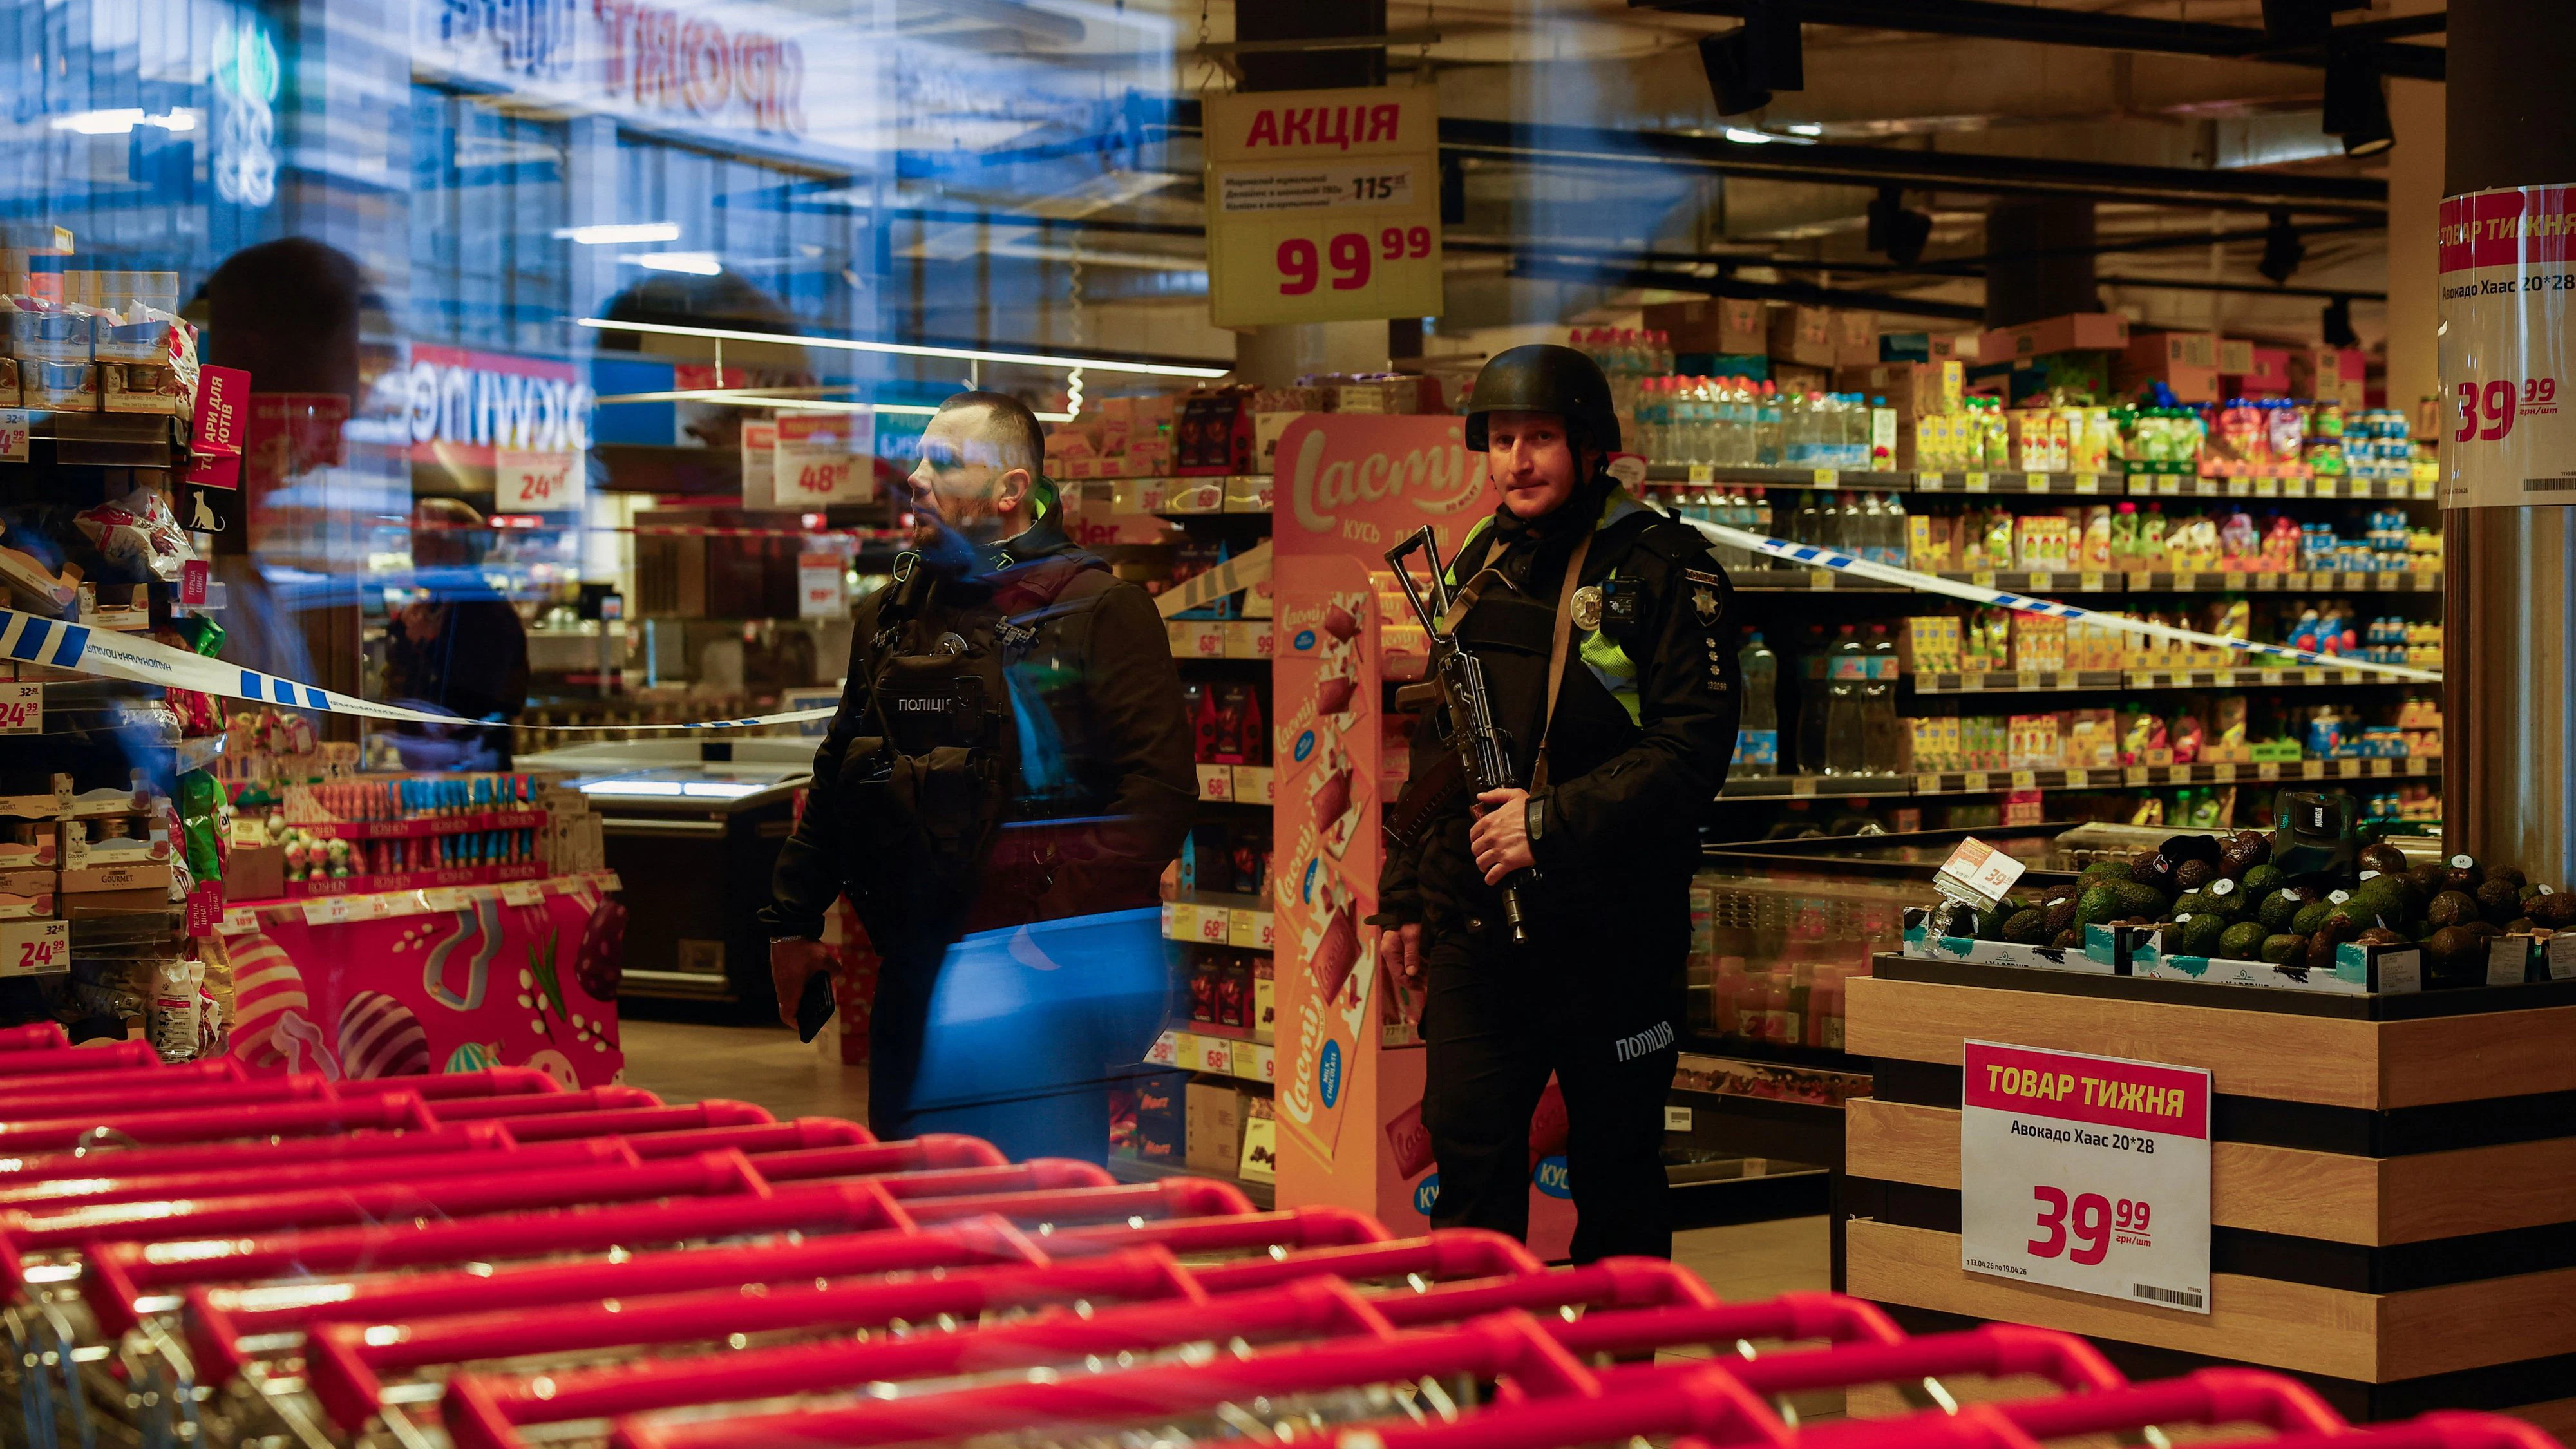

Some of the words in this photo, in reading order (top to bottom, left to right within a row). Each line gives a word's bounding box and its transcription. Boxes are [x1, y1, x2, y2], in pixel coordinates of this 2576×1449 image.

[1245, 103, 1400, 151] АКЦІЯ
[1352, 176, 1393, 200] 115
[1276, 233, 1372, 296] 99
[1381, 225, 1432, 260] 99
[2443, 284, 2478, 301] Авокадо
[2481, 279, 2515, 295] Хаас
[209, 375, 223, 410] ДЛЯ
[2456, 380, 2517, 443] 39
[2521, 378, 2556, 402] 99
[2519, 406, 2558, 416] грн/шт
[13, 430, 24, 439] 99
[520, 474, 551, 500] 24
[800, 464, 835, 492] 48
[1293, 426, 1464, 533] Lacmi
[1075, 518, 1120, 545] der
[1343, 518, 1381, 544] КУСЬ
[86, 643, 117, 659] ПОЛІЦІЯ
[117, 651, 173, 672] НАЦІОНАЛЬНА
[0, 703, 25, 727] 24
[26, 703, 37, 711] 99
[101, 875, 134, 884] GOURMET
[1985, 868, 2007, 886] 39
[1204, 920, 1220, 938] 68
[19, 941, 52, 967] 24
[53, 940, 64, 949] 99
[1616, 1020, 1674, 1063] ПОЛІЦІЯ
[1208, 1050, 1224, 1068] 68
[1266, 1060, 1274, 1077] 9
[1986, 1064, 2075, 1102] ТОВАР
[2080, 1077, 2186, 1119] ТИЖНЯ
[2011, 1119, 2071, 1144] Авокадо
[2074, 1128, 2109, 1148] Хаас
[1540, 1163, 1569, 1190] КУС
[2027, 1185, 2112, 1266] 39
[2116, 1198, 2152, 1231] 99
[2116, 1234, 2152, 1248] грн/шт
[1971, 1258, 1994, 1271] 13.04.26
[2003, 1264, 2027, 1276] 19.04.26
